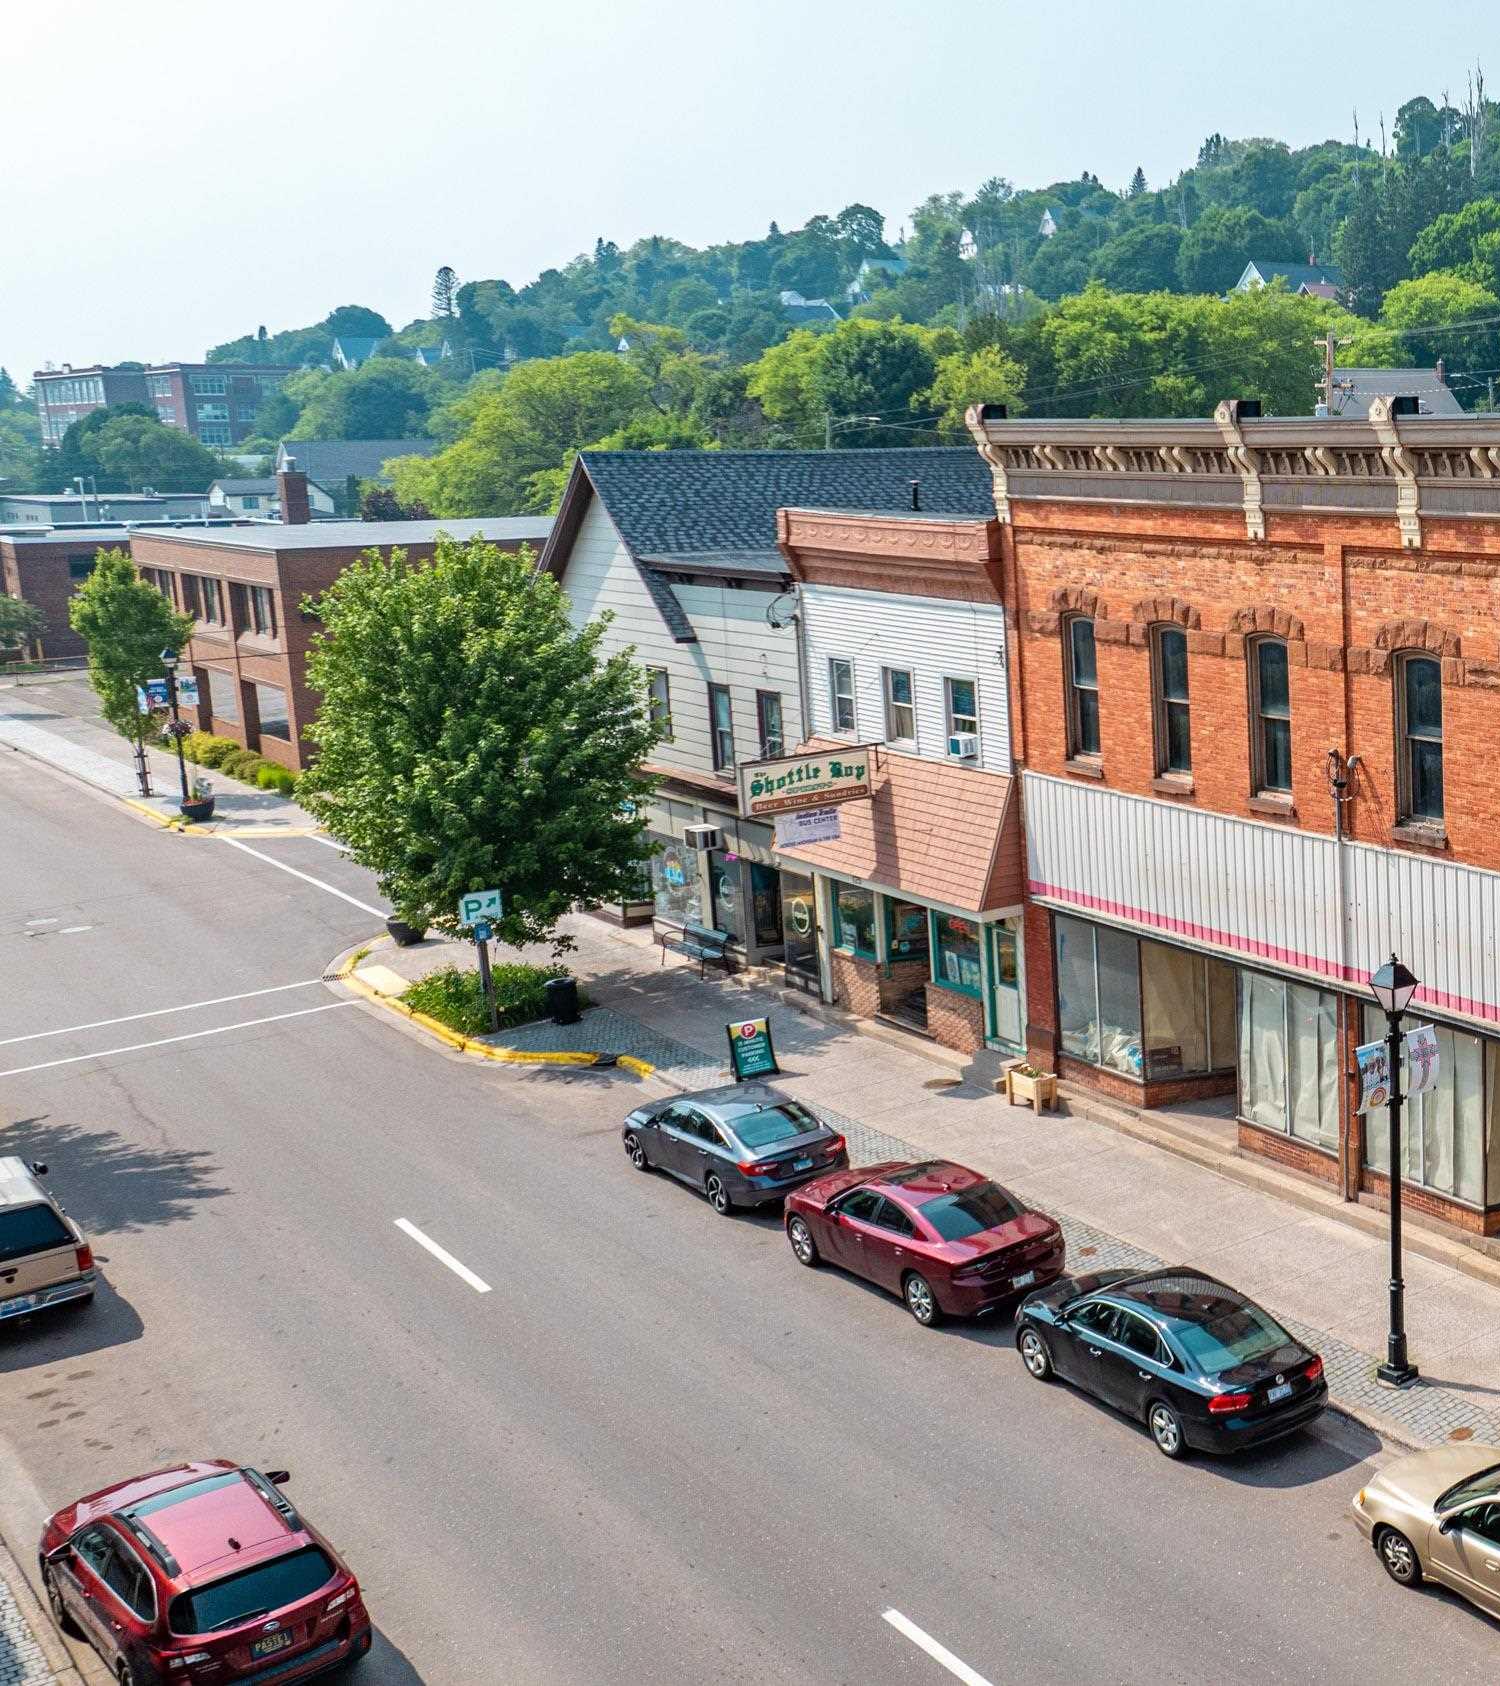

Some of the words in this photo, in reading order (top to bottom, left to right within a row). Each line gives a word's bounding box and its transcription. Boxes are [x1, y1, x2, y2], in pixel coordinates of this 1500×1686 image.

[756, 802, 778, 811] Beer
[784, 796, 807, 806] Wine
[814, 815, 838, 824] CENTER
[464, 900, 482, 920] P
[744, 1025, 753, 1036] P
